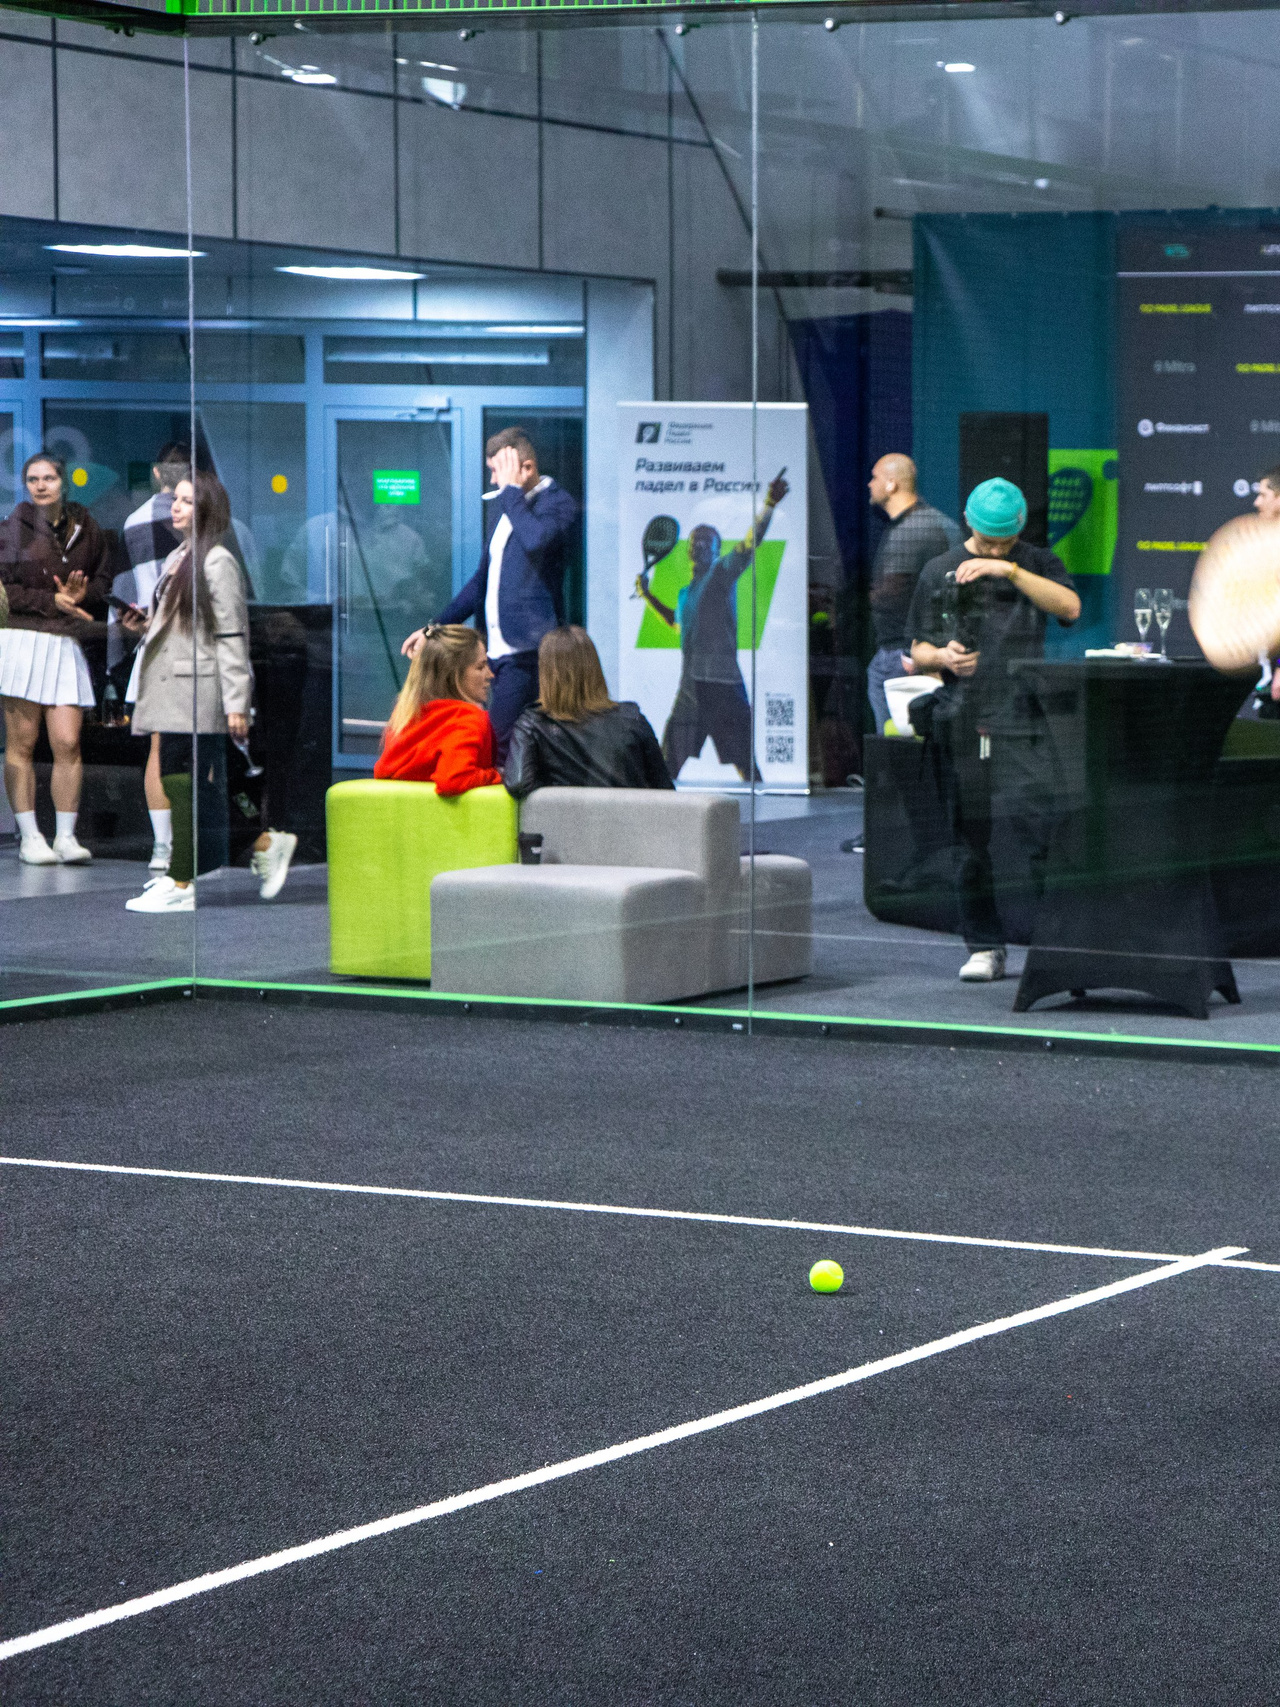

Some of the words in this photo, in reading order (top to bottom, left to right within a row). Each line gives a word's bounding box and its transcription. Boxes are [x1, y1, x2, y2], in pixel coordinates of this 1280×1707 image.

[635, 457, 725, 473] Развиваем
[635, 480, 685, 494] падел
[689, 481, 699, 492] в
